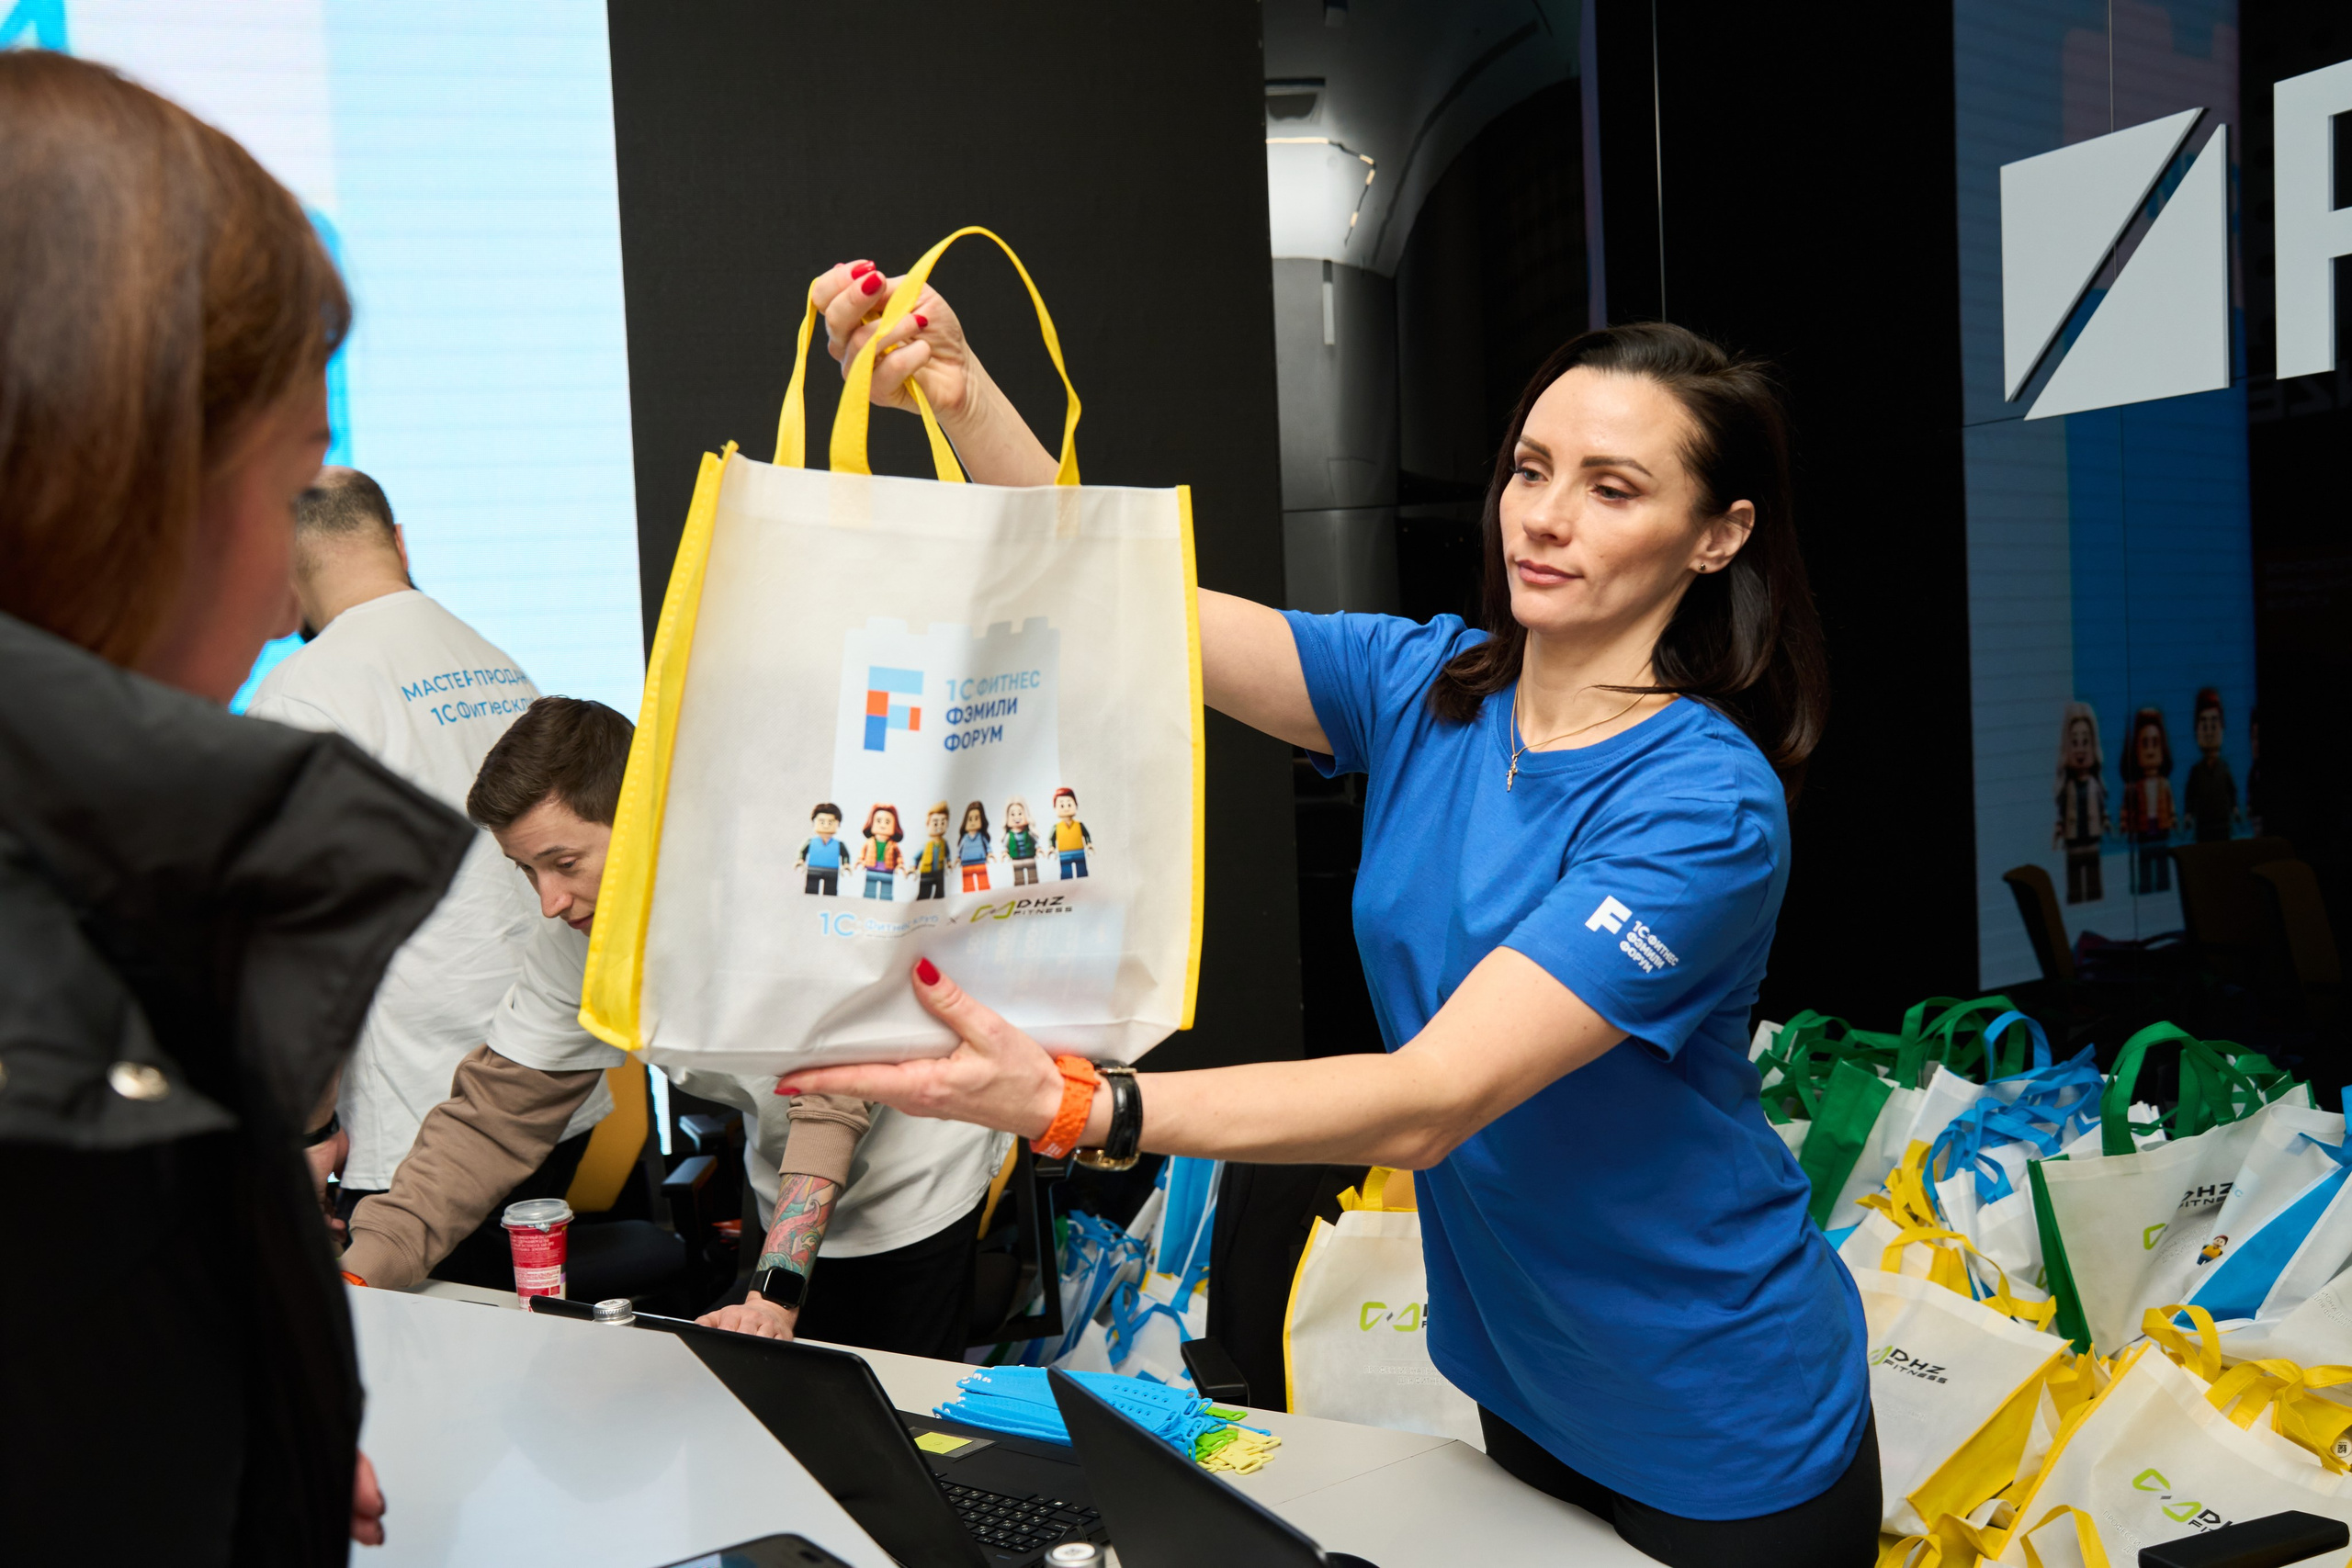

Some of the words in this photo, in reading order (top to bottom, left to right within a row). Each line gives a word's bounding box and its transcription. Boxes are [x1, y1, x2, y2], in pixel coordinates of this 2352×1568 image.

[401, 670, 473, 702] МАСТЕР
[945, 696, 1018, 726] ФЭМИЛИ
[944, 724, 1003, 751] ФОРУМ
[1013, 906, 1073, 916] FITNESS
[1016, 896, 1065, 908] DHZ
[1584, 895, 1633, 935] F
[1619, 941, 1654, 974] ФОРУМ
[1626, 931, 1666, 970] ФЭМИЛИ
[1883, 1359, 1949, 1384] FITNESS
[1890, 1348, 1946, 1374] DHZ
